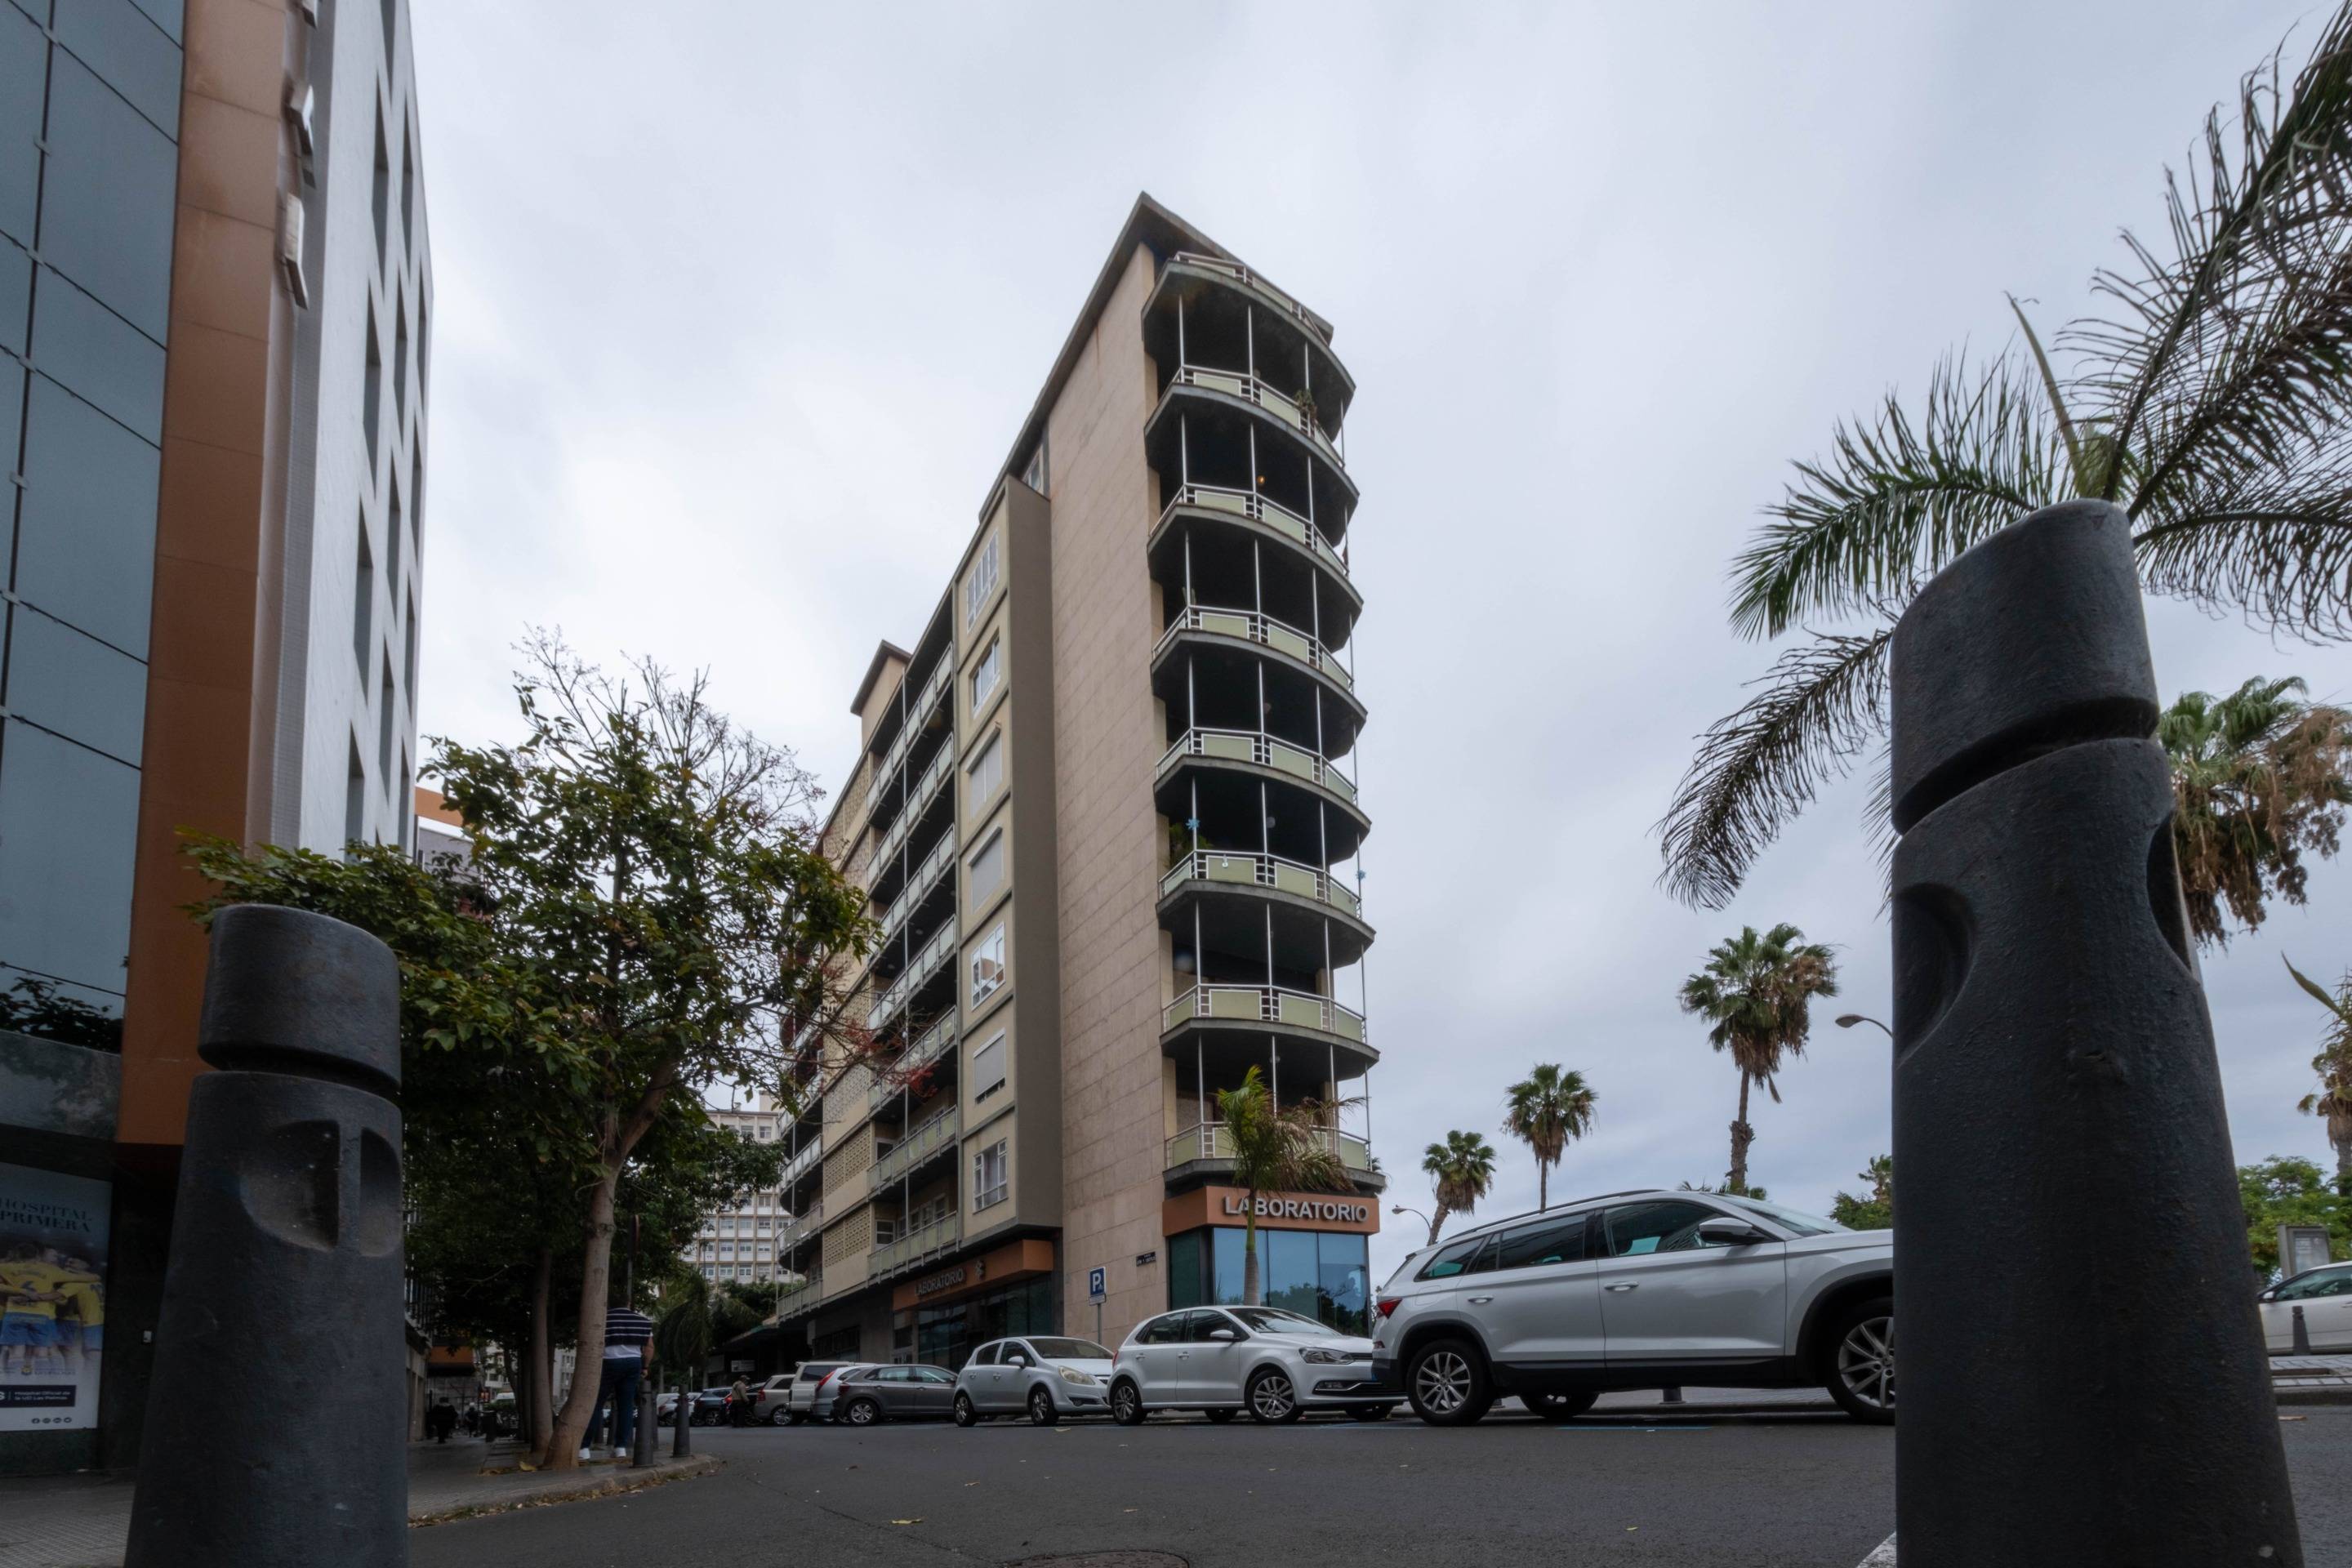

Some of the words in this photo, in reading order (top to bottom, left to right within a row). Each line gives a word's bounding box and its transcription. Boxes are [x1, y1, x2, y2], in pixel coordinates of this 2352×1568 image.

[1224, 1196, 1369, 1222] LABORATORIO
[0, 1210, 91, 1233] PRIMERA
[914, 1268, 964, 1297] LABORATORIO
[1092, 1272, 1102, 1292] P
